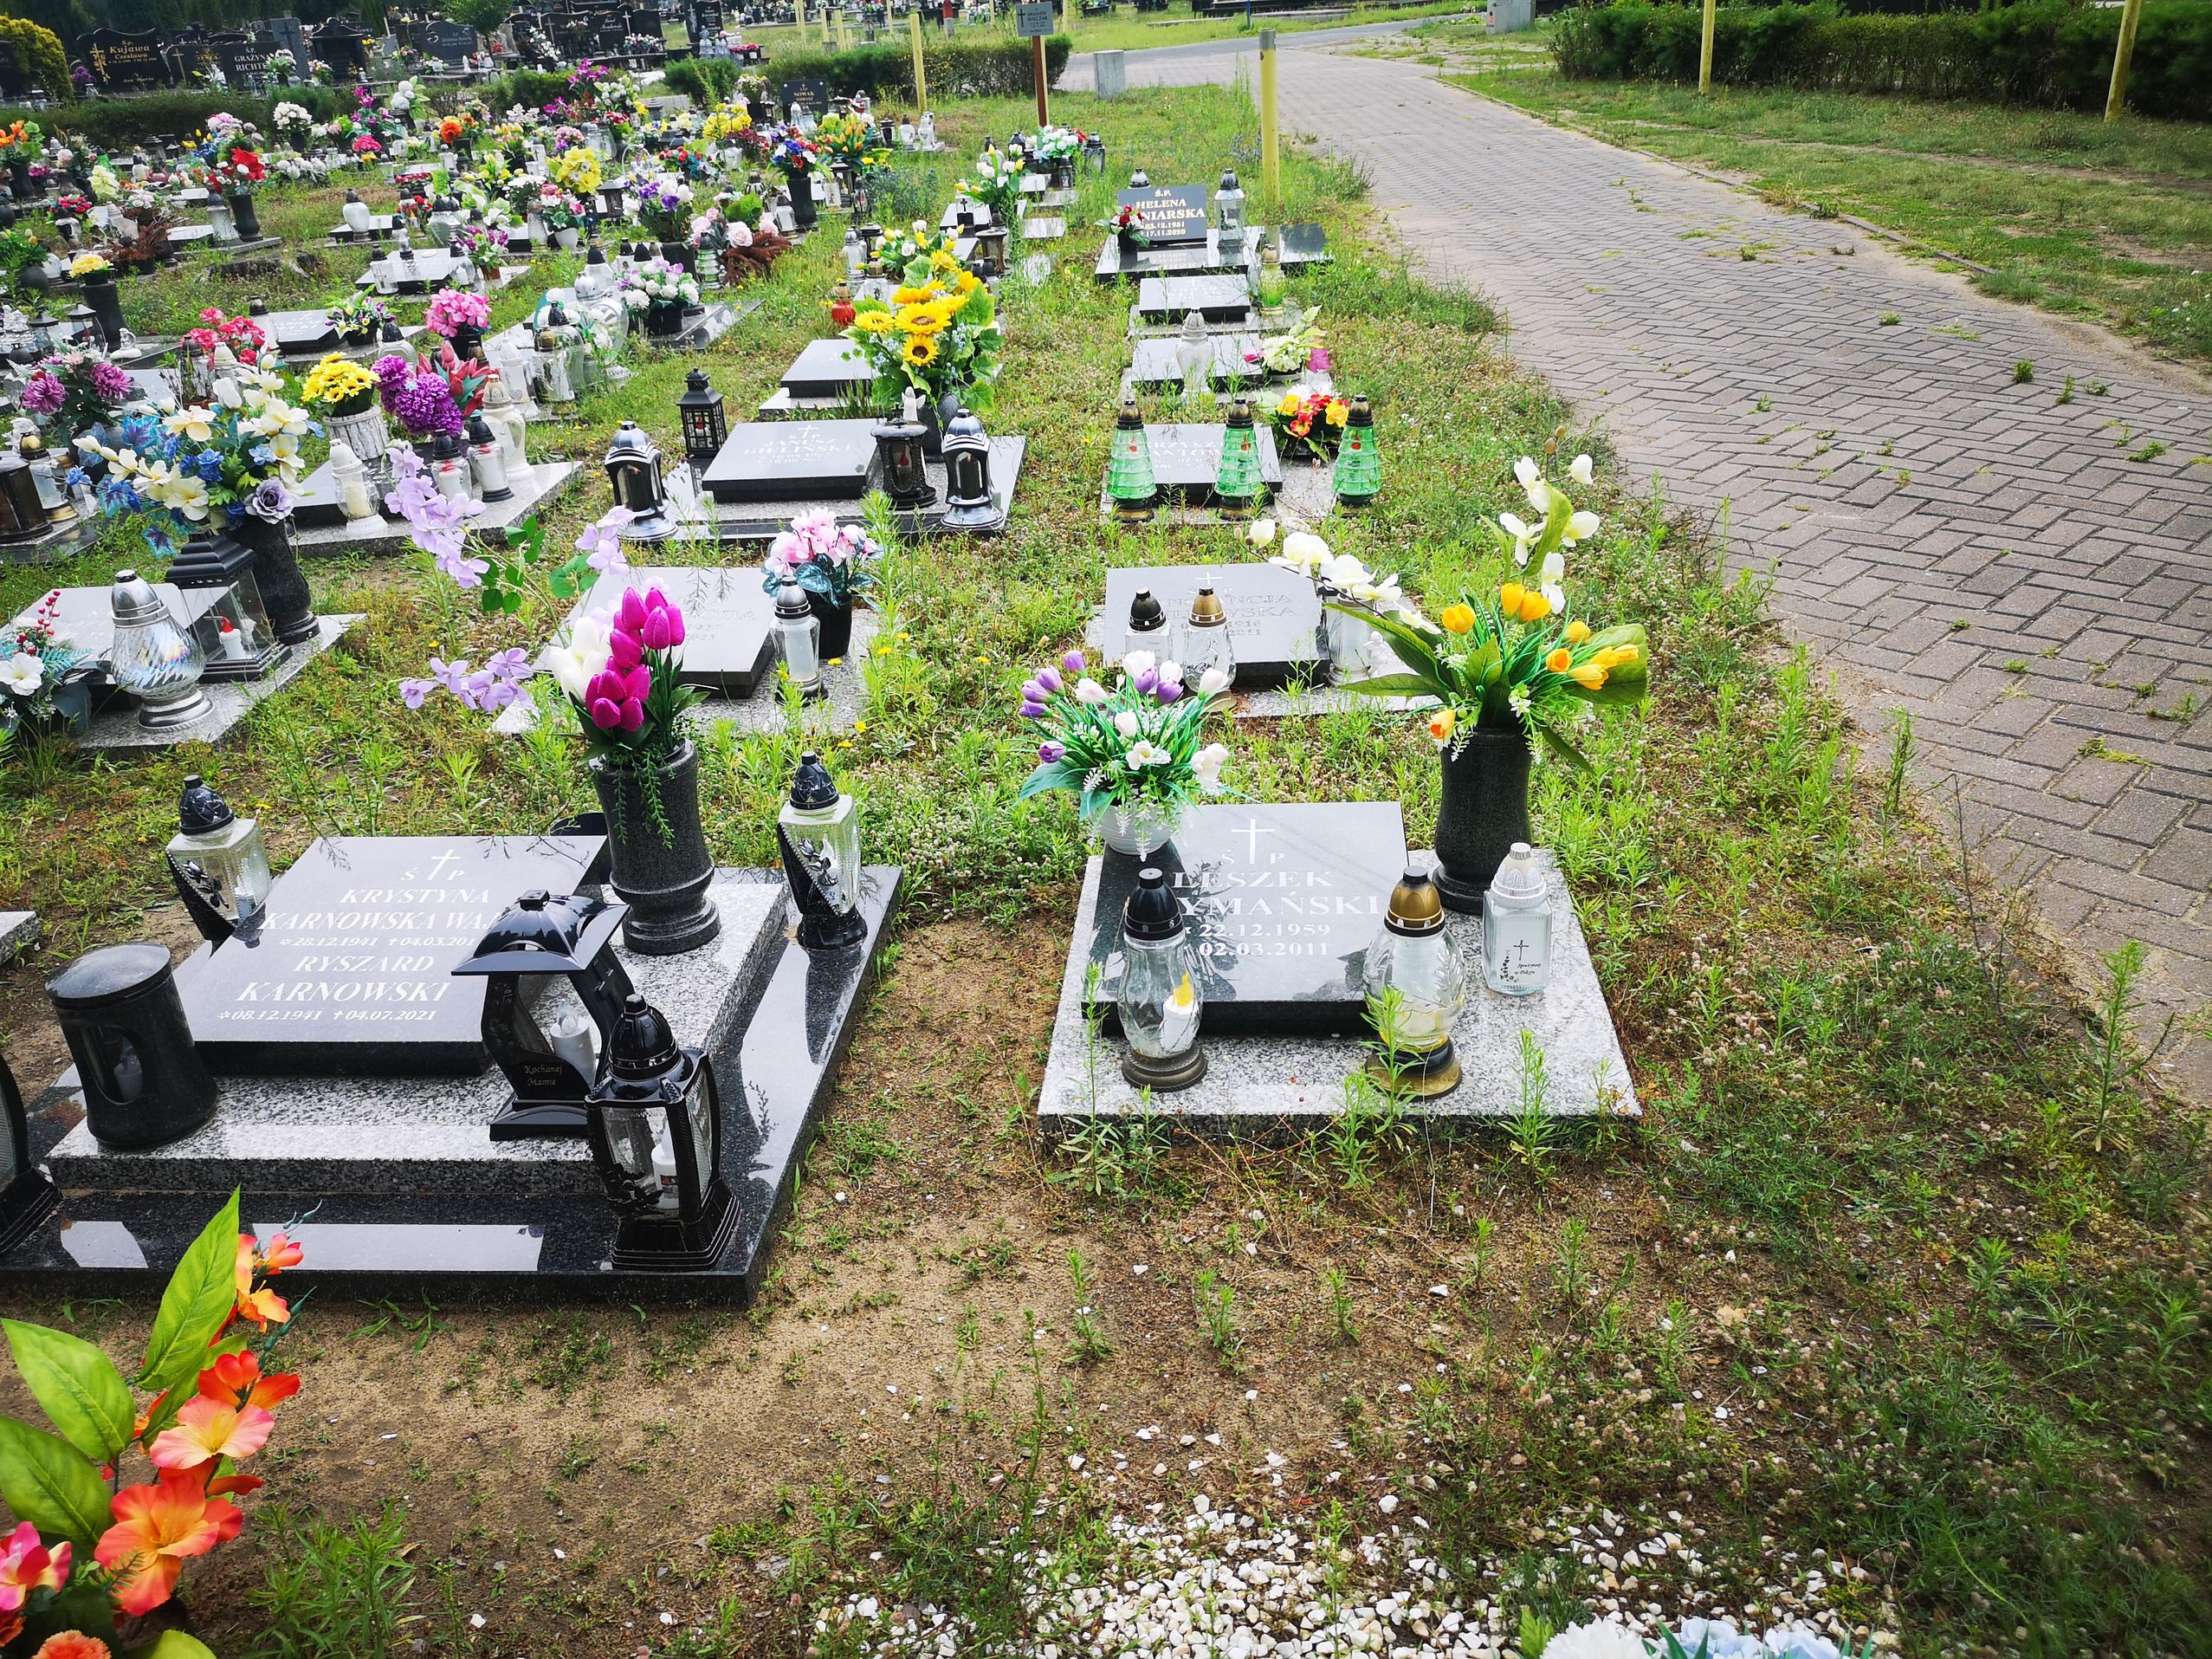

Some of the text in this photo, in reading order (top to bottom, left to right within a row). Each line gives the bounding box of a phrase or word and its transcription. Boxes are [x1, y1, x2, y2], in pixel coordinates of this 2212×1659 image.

[110, 45, 150, 55] Kujawa
[234, 54, 268, 62] GRAŻYN
[1135, 198, 1187, 209] HELENA
[1141, 208, 1206, 221] NIARSKA
[1270, 852, 1285, 865] P
[446, 869, 465, 881] P
[1172, 871, 1334, 889] LESZEK
[340, 889, 489, 904] KRYSTYNA
[1176, 891, 1380, 916] YMAŃSKI
[256, 911, 500, 930] KARNOWSKA WAJ
[1199, 923, 1331, 937] 22.12.1959
[292, 936, 475, 947] 28.12.1941 04.03.201
[1199, 941, 1329, 956] 02.03.2011
[293, 956, 435, 972] RYSZARD
[236, 982, 450, 1001] KARNOWSKI
[230, 1010, 437, 1021] 08.12.1941 04.07.2021
[523, 1064, 563, 1075] Kochanej
[527, 1077, 556, 1086] Mamie
